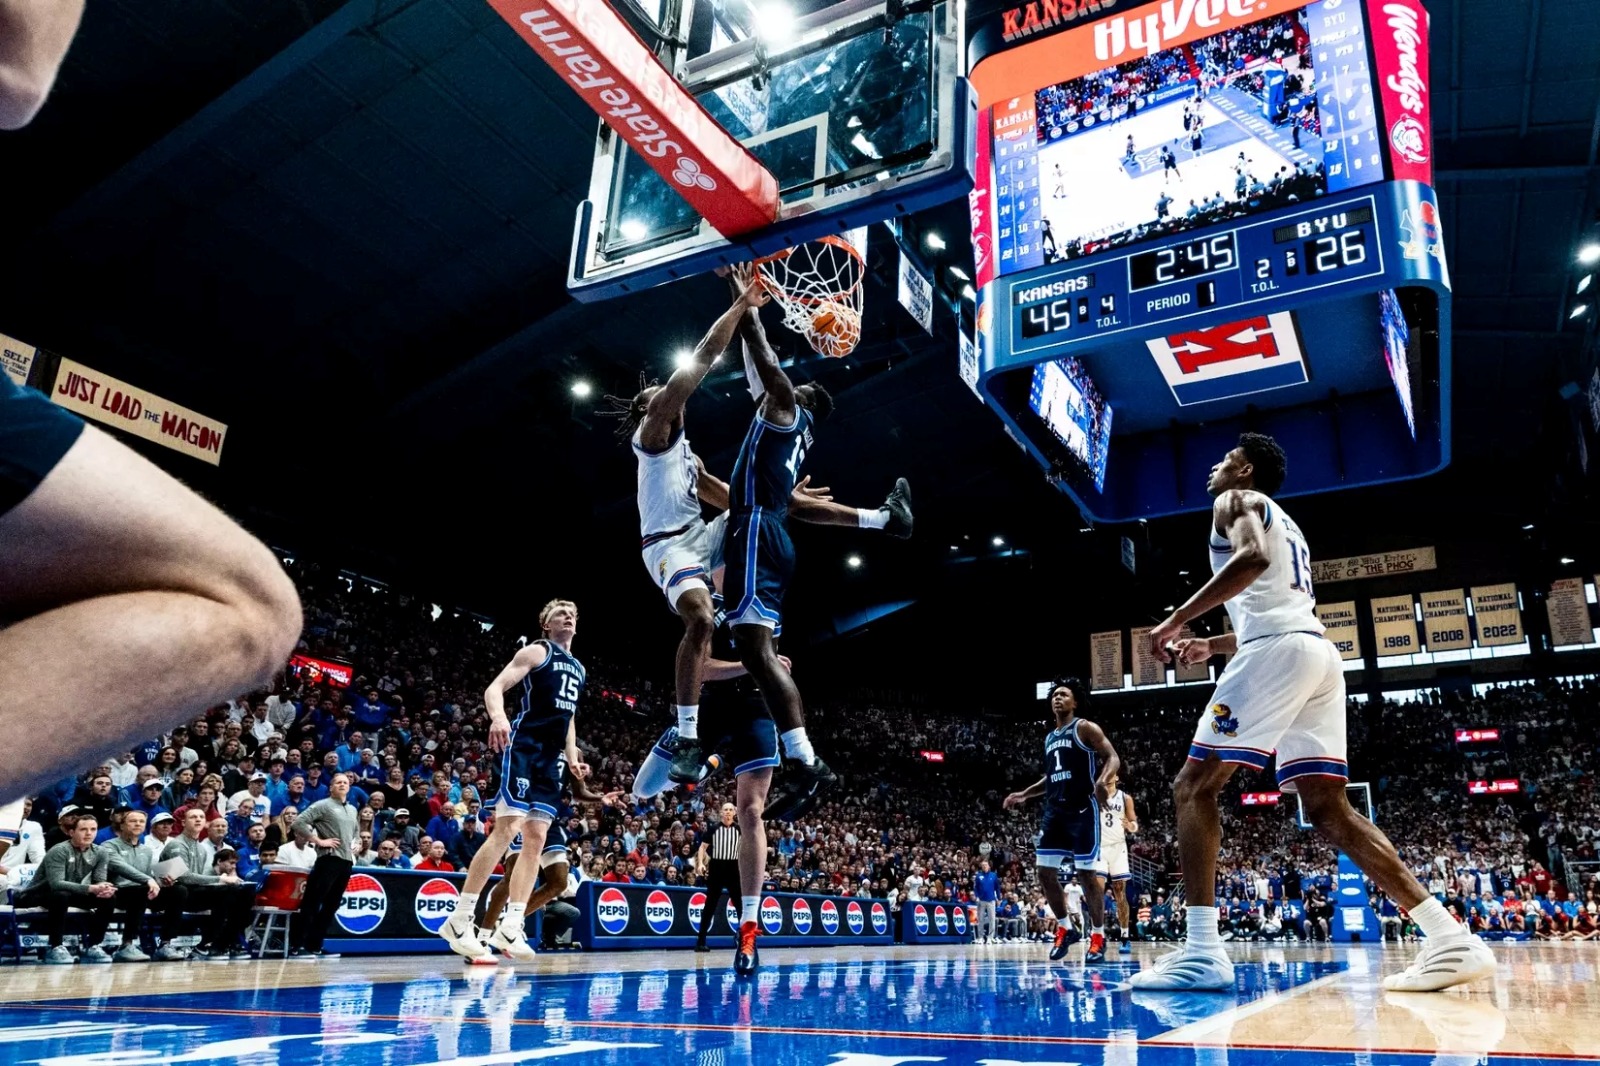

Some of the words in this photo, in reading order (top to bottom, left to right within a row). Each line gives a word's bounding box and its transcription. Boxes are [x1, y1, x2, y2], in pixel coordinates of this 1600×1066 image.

[1323, 11, 1346, 28] BYU
[1382, 3, 1426, 114] Wendy's
[996, 109, 1034, 130] KANSAS
[1297, 213, 1348, 238] BYU
[1316, 230, 1367, 272] 26
[1156, 235, 1233, 283] 2:45
[1257, 258, 1270, 279] 2
[1018, 276, 1088, 304] KANSAS
[1208, 282, 1215, 303] 1
[1251, 282, 1280, 294] T.O.L.
[1079, 305, 1087, 315] B
[1101, 296, 1114, 312] 4
[1147, 293, 1191, 313] PERIOD
[1030, 300, 1070, 332] 45
[1096, 317, 1122, 328] T.O.L.
[4, 349, 31, 365] SELF
[58, 371, 101, 405] JUST
[101, 387, 143, 421] LOAD
[144, 409, 161, 424] THE
[161, 411, 222, 454] WAGON
[1311, 568, 1341, 581] EWARE
[1346, 567, 1359, 578] OF
[1427, 598, 1461, 609] NATIONAL
[1477, 592, 1514, 603] NATIONAL
[1376, 604, 1410, 614] NATIONAL
[1424, 608, 1466, 619] CHAMPIONS
[1475, 602, 1518, 613] CHAMPIONS
[1321, 610, 1353, 620] NATIONAL
[1374, 613, 1415, 624] CHAMPIONS
[1432, 629, 1464, 643] 2008
[1483, 624, 1517, 638] 2022
[1384, 634, 1411, 648] 1988
[558, 673, 580, 702] 15
[1046, 739, 1073, 756] BRIGHAM
[1053, 750, 1063, 771] 1
[1050, 770, 1072, 783] YOUNG
[1105, 812, 1113, 828] 3
[418, 899, 456, 912] PEPS
[600, 905, 628, 917] PEPSI
[647, 908, 673, 918] PEPSI
[762, 910, 783, 921] PEPSI
[794, 912, 812, 921] PEPSI
[821, 913, 838, 922] PEPSI
[847, 914, 863, 922] PEPSI
[872, 915, 886, 923] PEPSI
[915, 916, 928, 924] PEPSI
